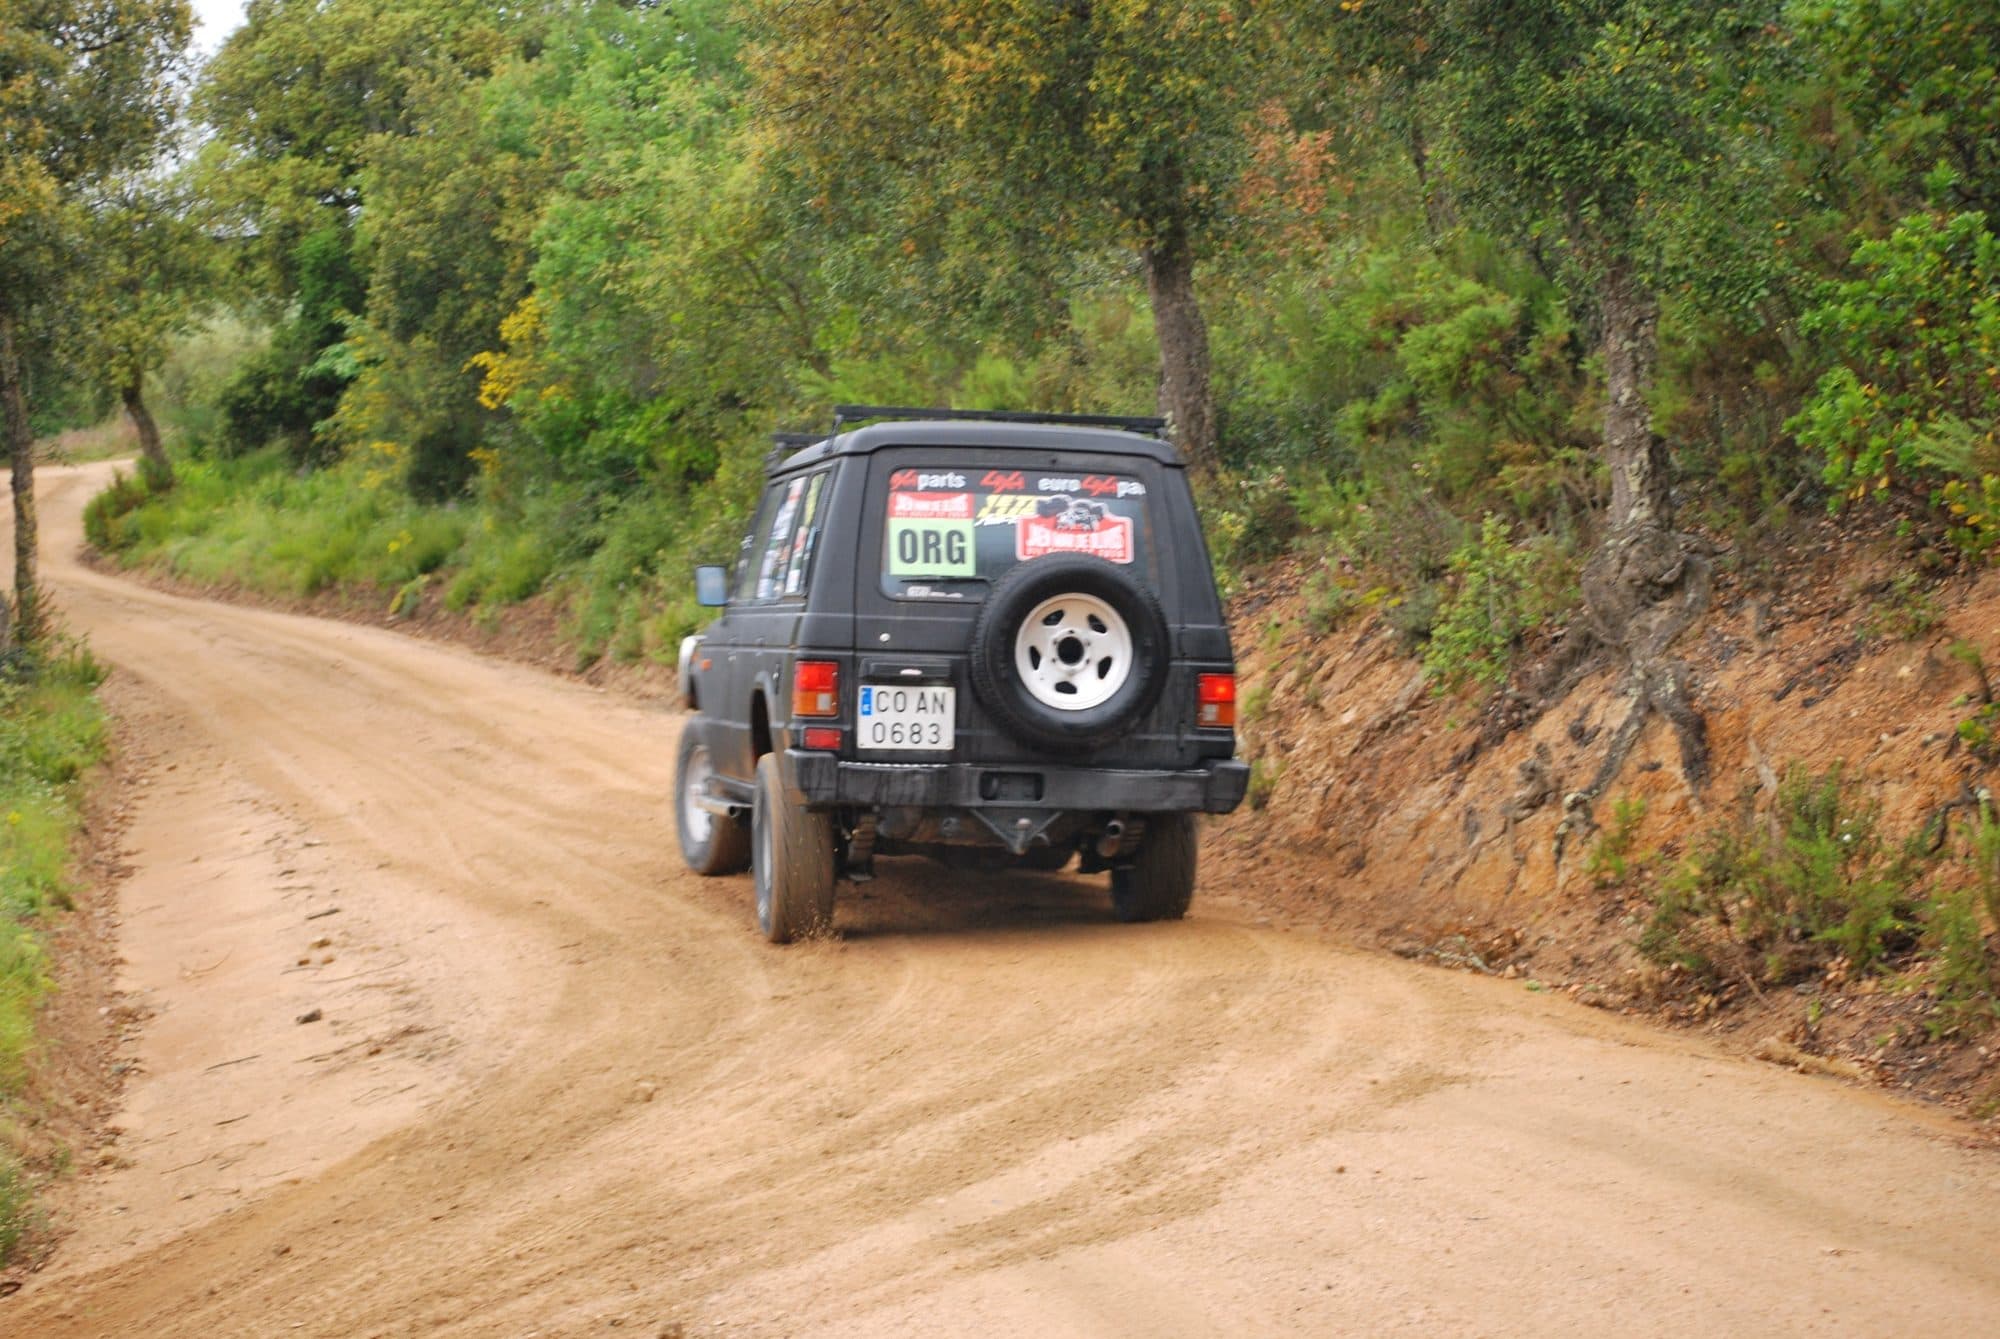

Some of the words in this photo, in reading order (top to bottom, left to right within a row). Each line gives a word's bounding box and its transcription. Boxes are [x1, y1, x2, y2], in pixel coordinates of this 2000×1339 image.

[898, 529, 966, 565] ORG
[877, 691, 907, 713] CO
[916, 691, 946, 714] AN
[872, 722, 940, 745] 0683
